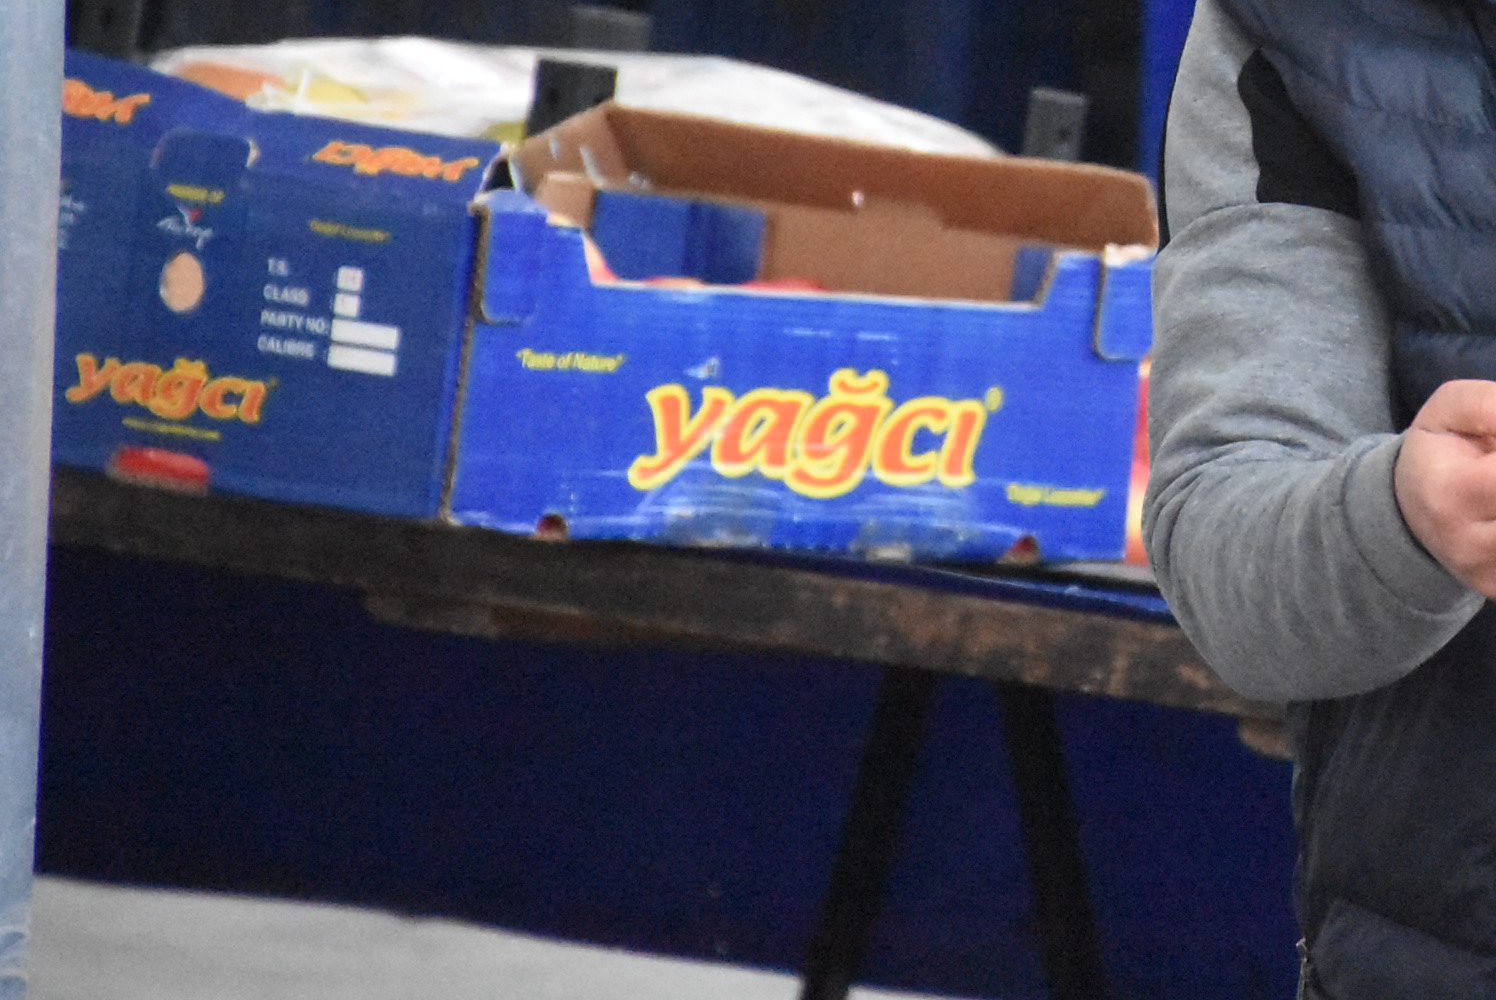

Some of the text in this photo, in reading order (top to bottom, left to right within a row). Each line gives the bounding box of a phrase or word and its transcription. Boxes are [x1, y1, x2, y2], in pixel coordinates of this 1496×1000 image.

[65, 352, 266, 424] yağcı
[557, 352, 573, 369] of
[627, 367, 987, 499] yağcı
